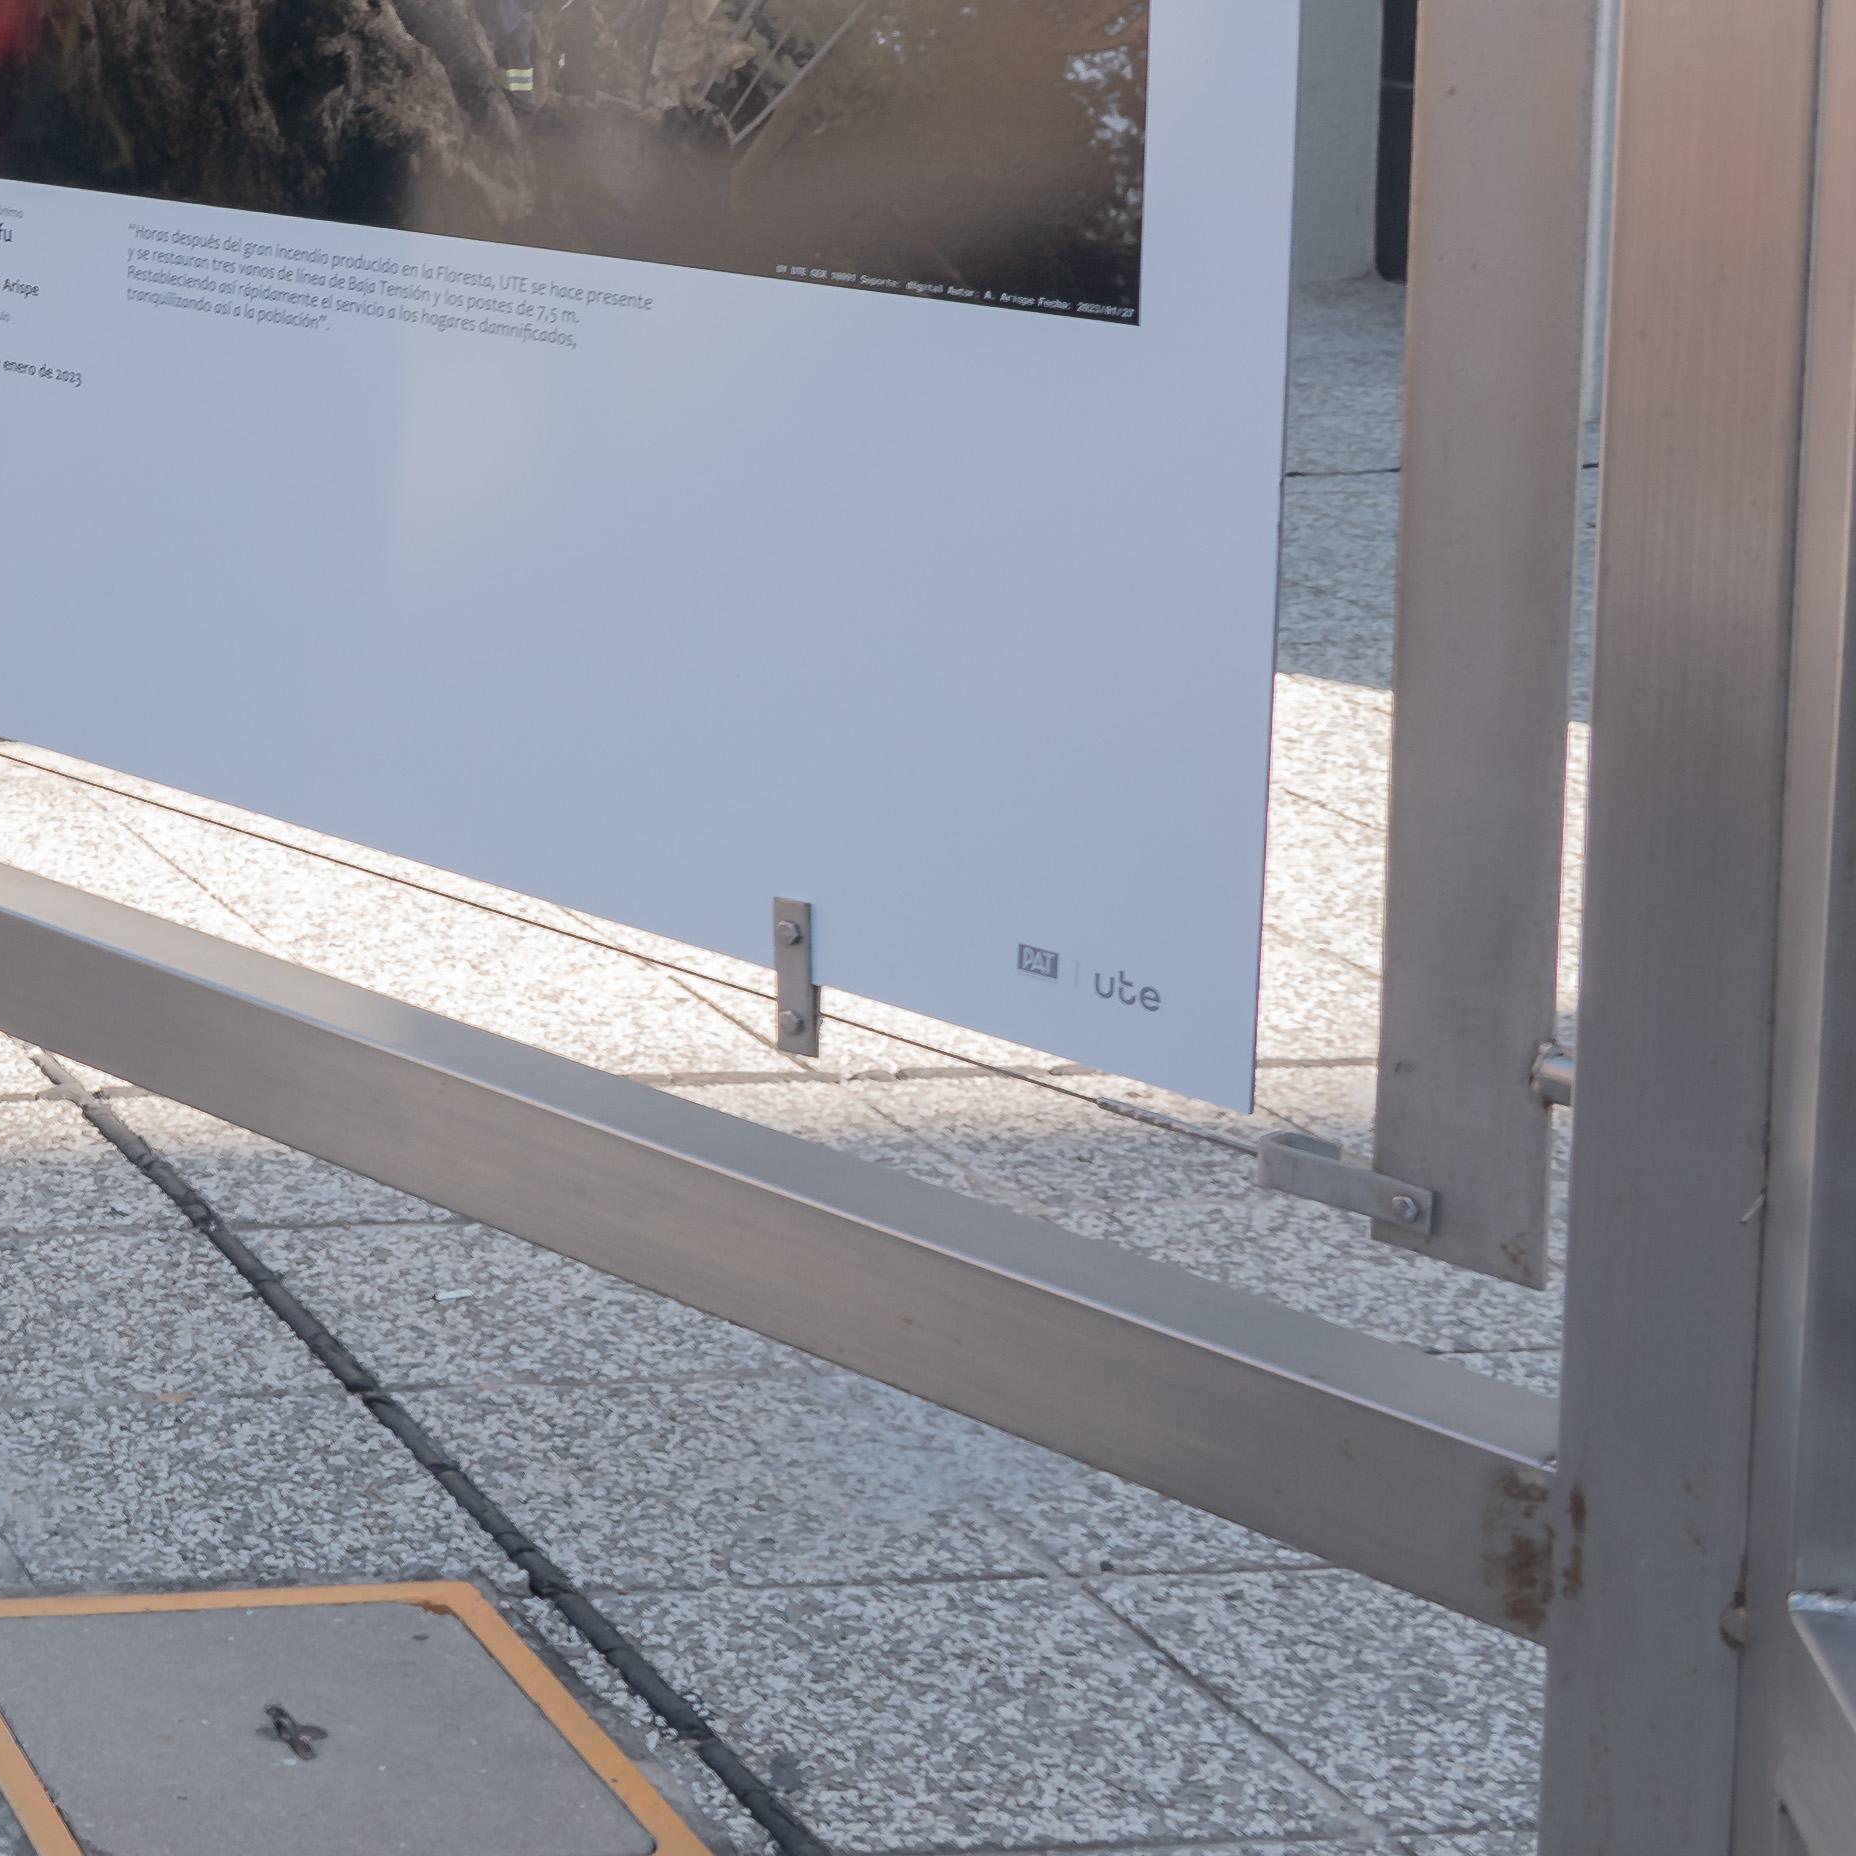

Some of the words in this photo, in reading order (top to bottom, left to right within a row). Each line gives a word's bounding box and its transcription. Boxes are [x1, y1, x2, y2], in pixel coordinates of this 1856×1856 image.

[2, 278, 40, 299] Arispe
[127, 248, 135, 262] y
[136, 249, 150, 261] se
[152, 251, 209, 269] restauran
[212, 258, 236, 273] tres
[239, 262, 275, 280] vanos
[277, 265, 293, 282] de
[329, 273, 345, 290] de
[349, 276, 376, 296] Baja
[379, 280, 430, 302] Tensión
[432, 291, 441, 306] y
[444, 290, 463, 306] los
[466, 295, 513, 315] postes
[516, 300, 534, 317] de
[172, 228, 220, 249] después
[223, 237, 241, 252] del
[244, 241, 272, 259] gran
[275, 242, 329, 265] incendio
[332, 252, 398, 276] producido
[401, 263, 418, 278] en
[422, 262, 433, 279] la
[436, 266, 496, 291] Floresta,
[500, 274, 528, 293] UTE
[531, 282, 546, 296] se
[550, 280, 584, 299] hace
[586, 288, 653, 310] presente
[126, 286, 211, 313] tranquilizando
[233, 305, 241, 317] a
[244, 302, 255, 319] la
[127, 265, 216, 292] Restableciendo
[238, 281, 318, 308] rápidamente
[320, 292, 333, 309] el
[336, 297, 385, 317] servicio
[388, 309, 396, 320] a
[399, 304, 417, 323] los
[421, 308, 475, 332] hogares
[478, 318, 577, 349] damnificados,
[2, 359, 36, 376] enero
[38, 363, 53, 380] de
[56, 369, 83, 388] 2023
[1094, 970, 1161, 1012] ute
